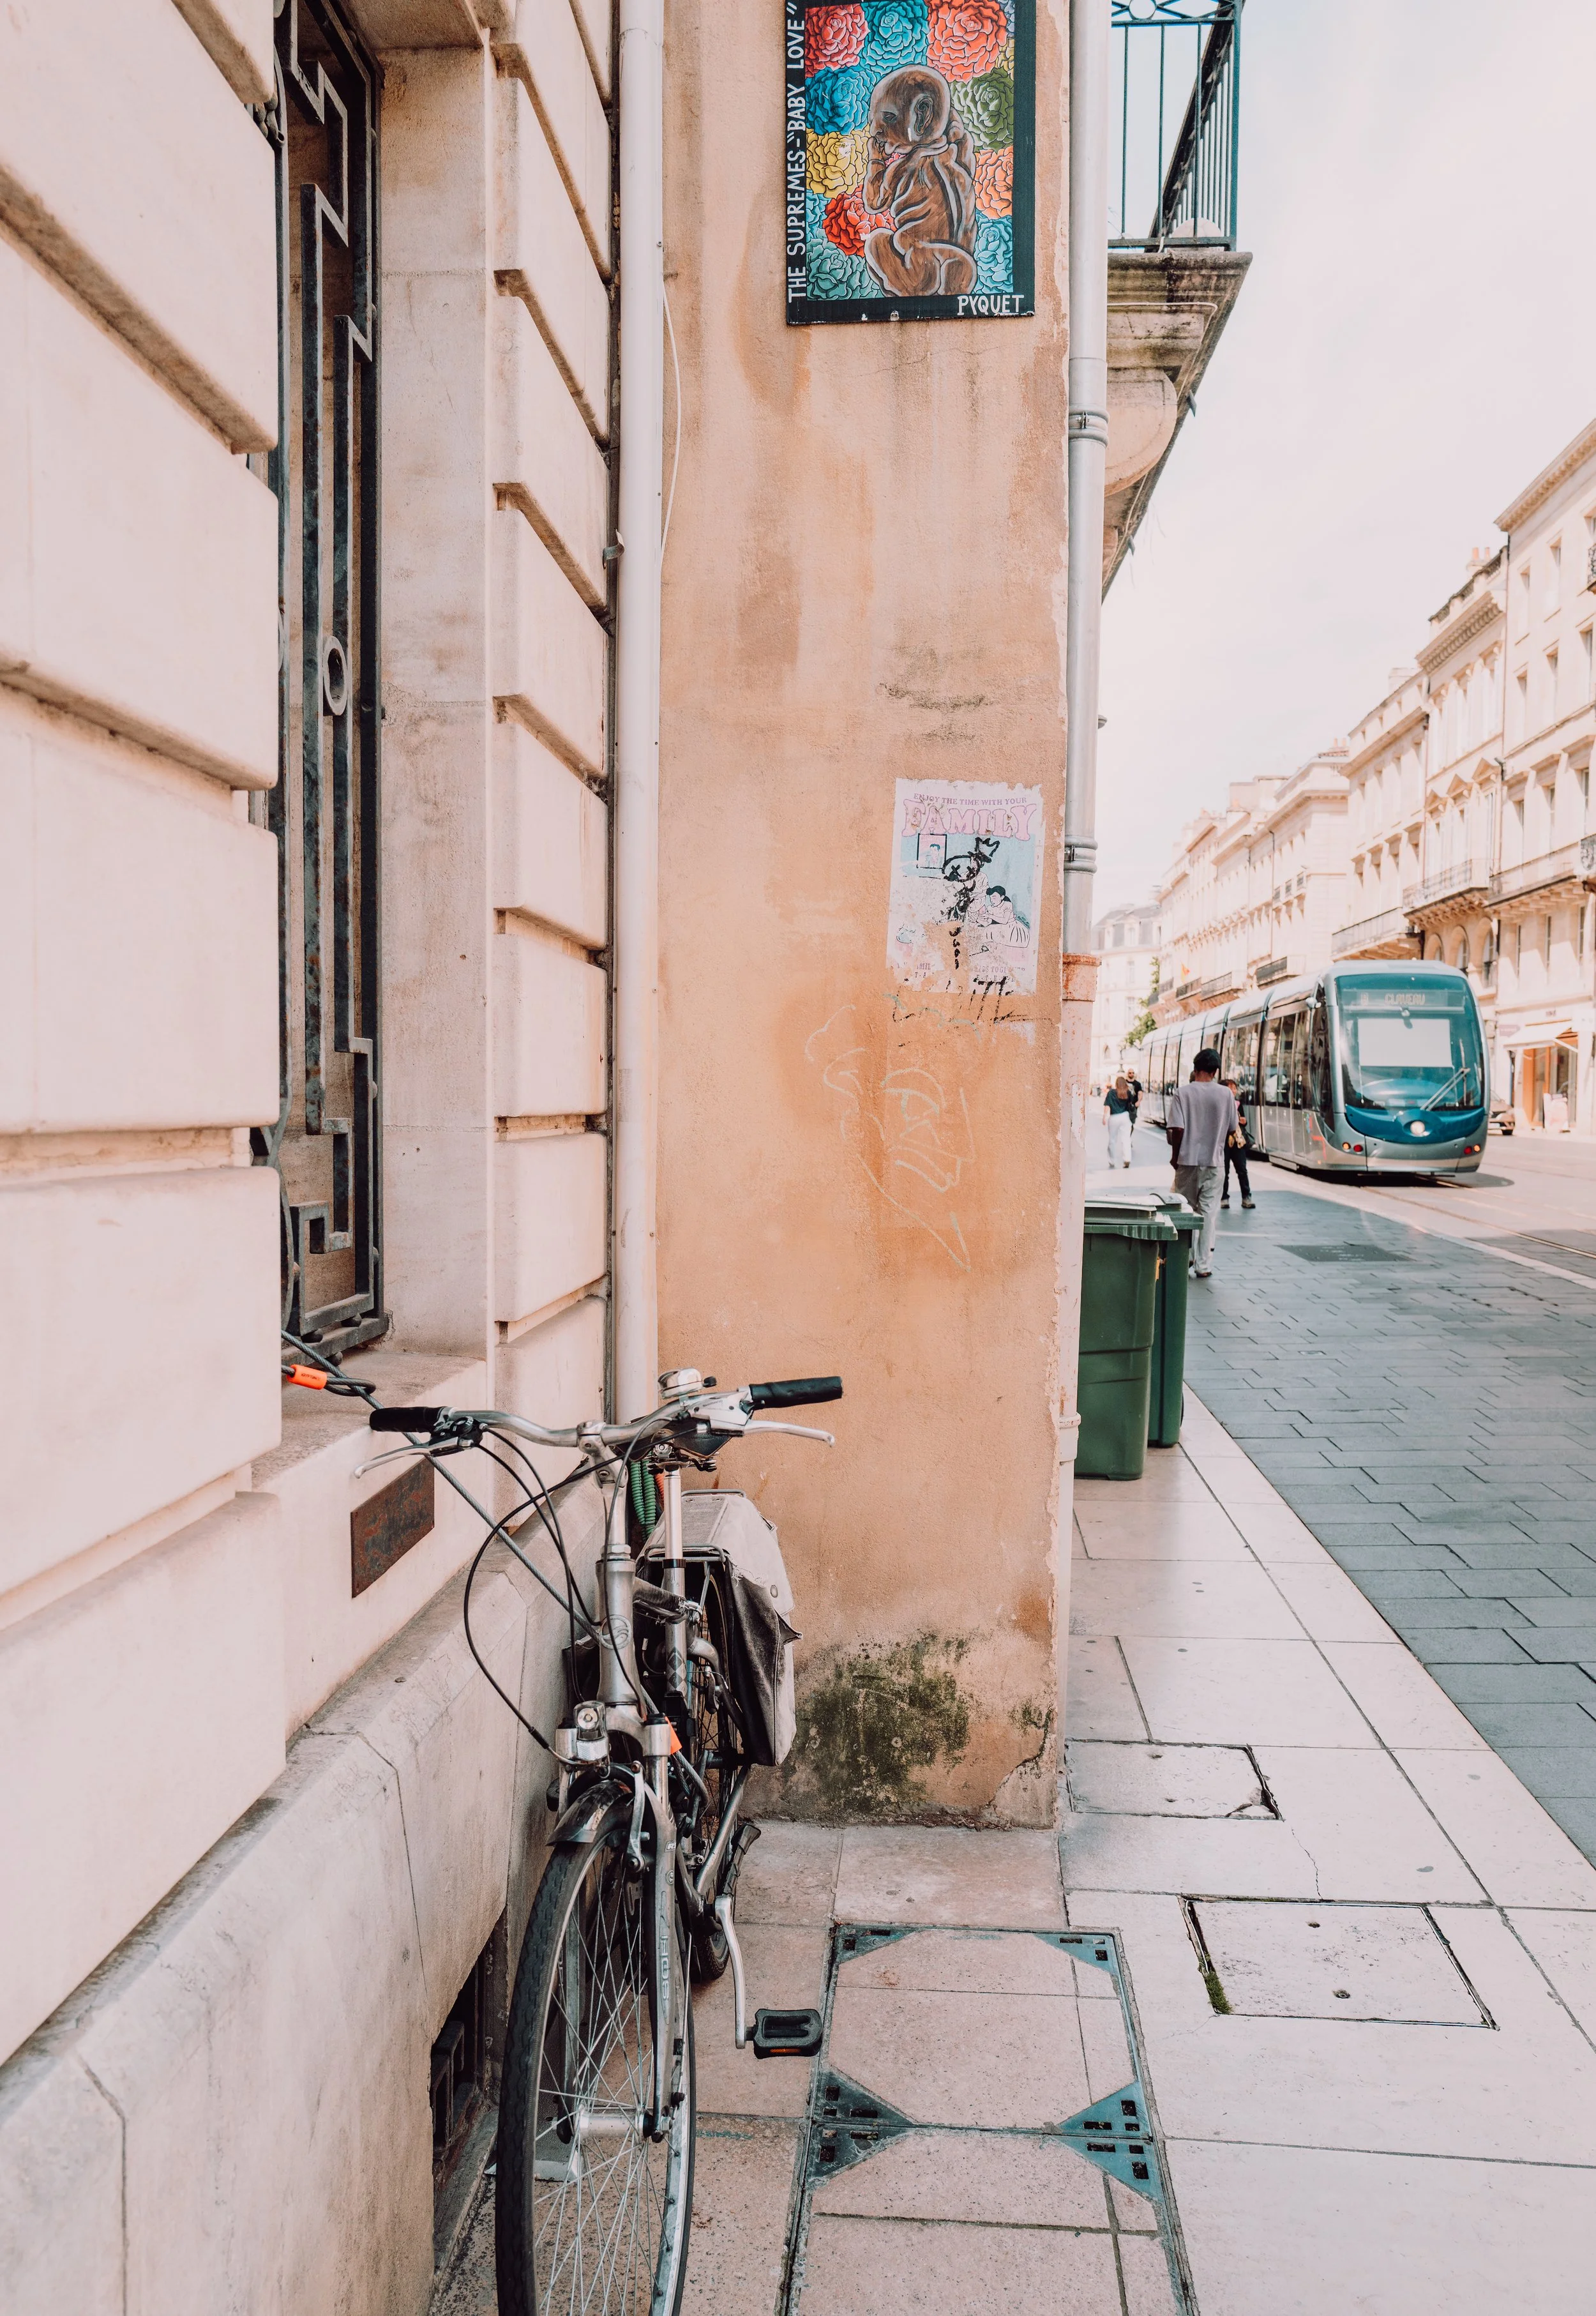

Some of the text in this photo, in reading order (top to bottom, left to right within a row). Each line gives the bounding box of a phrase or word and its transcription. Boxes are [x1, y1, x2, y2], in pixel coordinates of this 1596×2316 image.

[787, 267, 807, 303] THE
[957, 294, 1025, 315] PYQUET
[914, 793, 940, 803] ENJOY
[901, 798, 1037, 841] FAMILY
